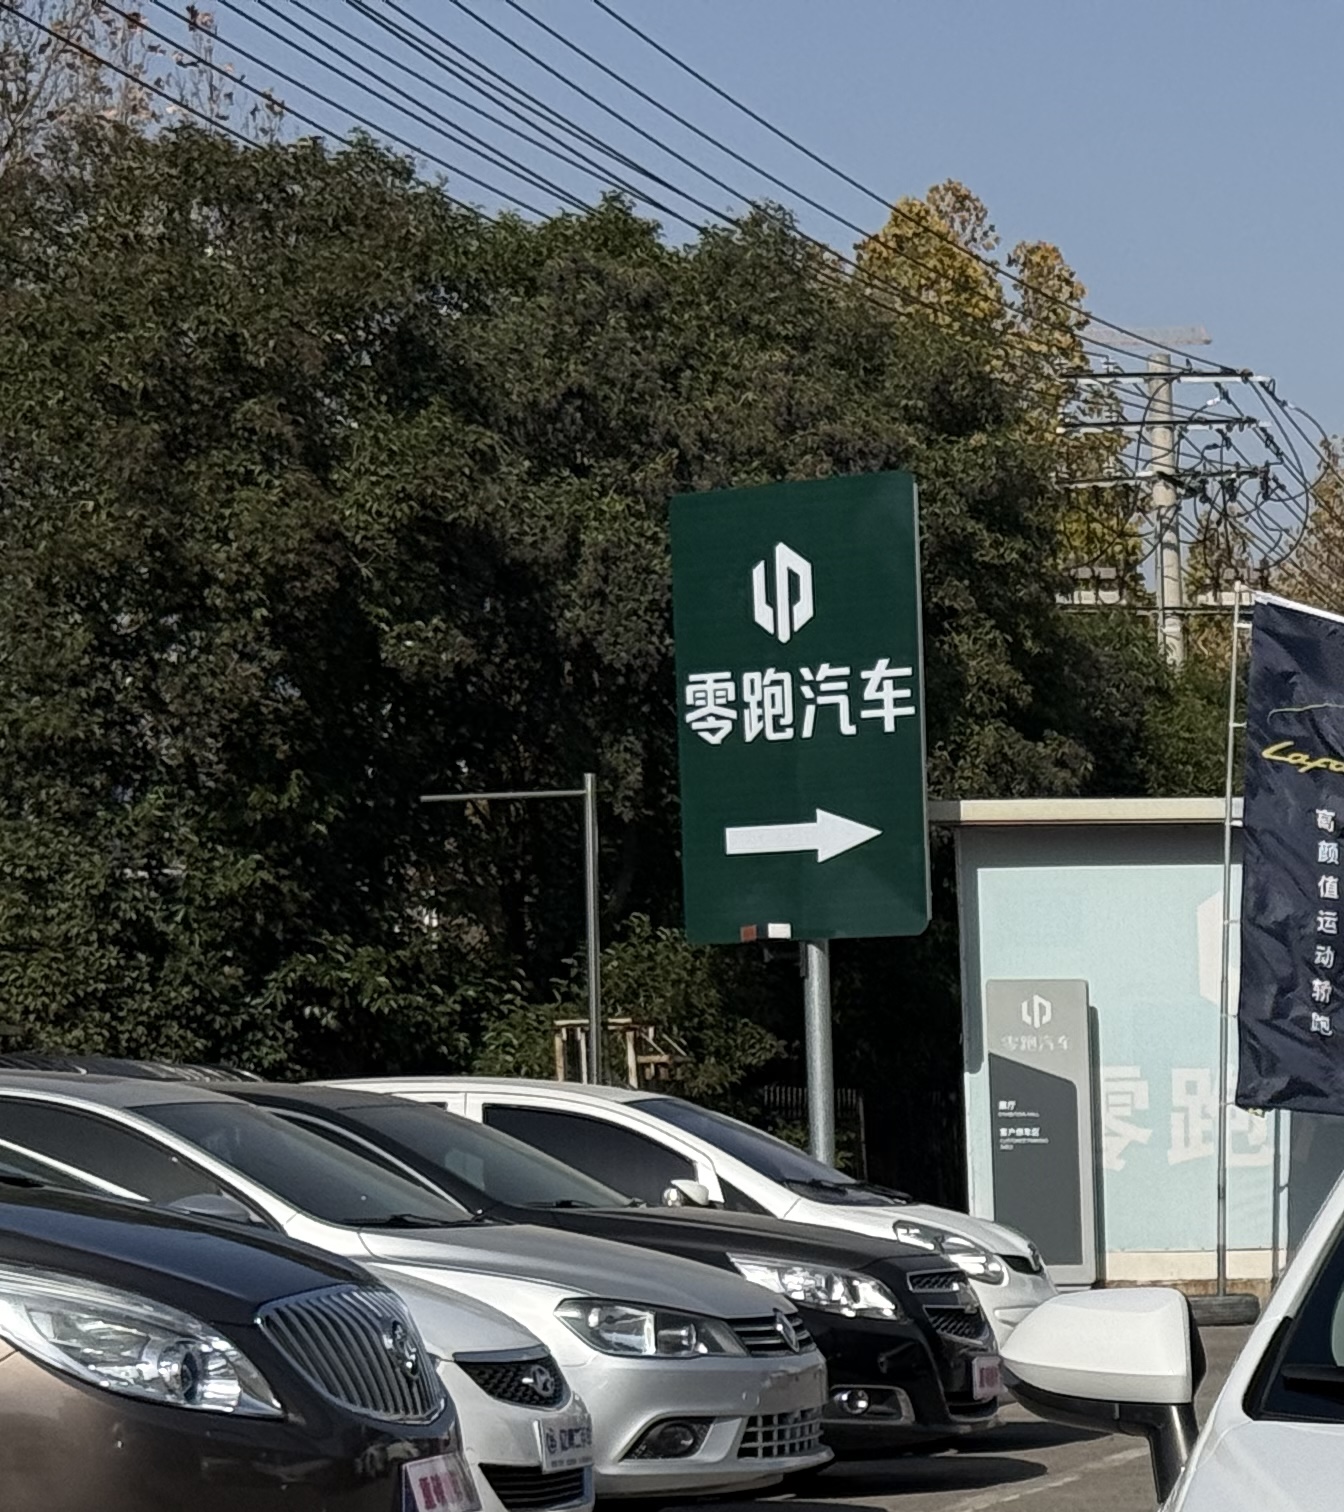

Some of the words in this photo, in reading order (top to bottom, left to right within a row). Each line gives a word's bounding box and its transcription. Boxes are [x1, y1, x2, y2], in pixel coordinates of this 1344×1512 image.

[685, 657, 916, 745] 零跑汽车
[1311, 808, 1341, 1037] 高颜值运动轿跑
